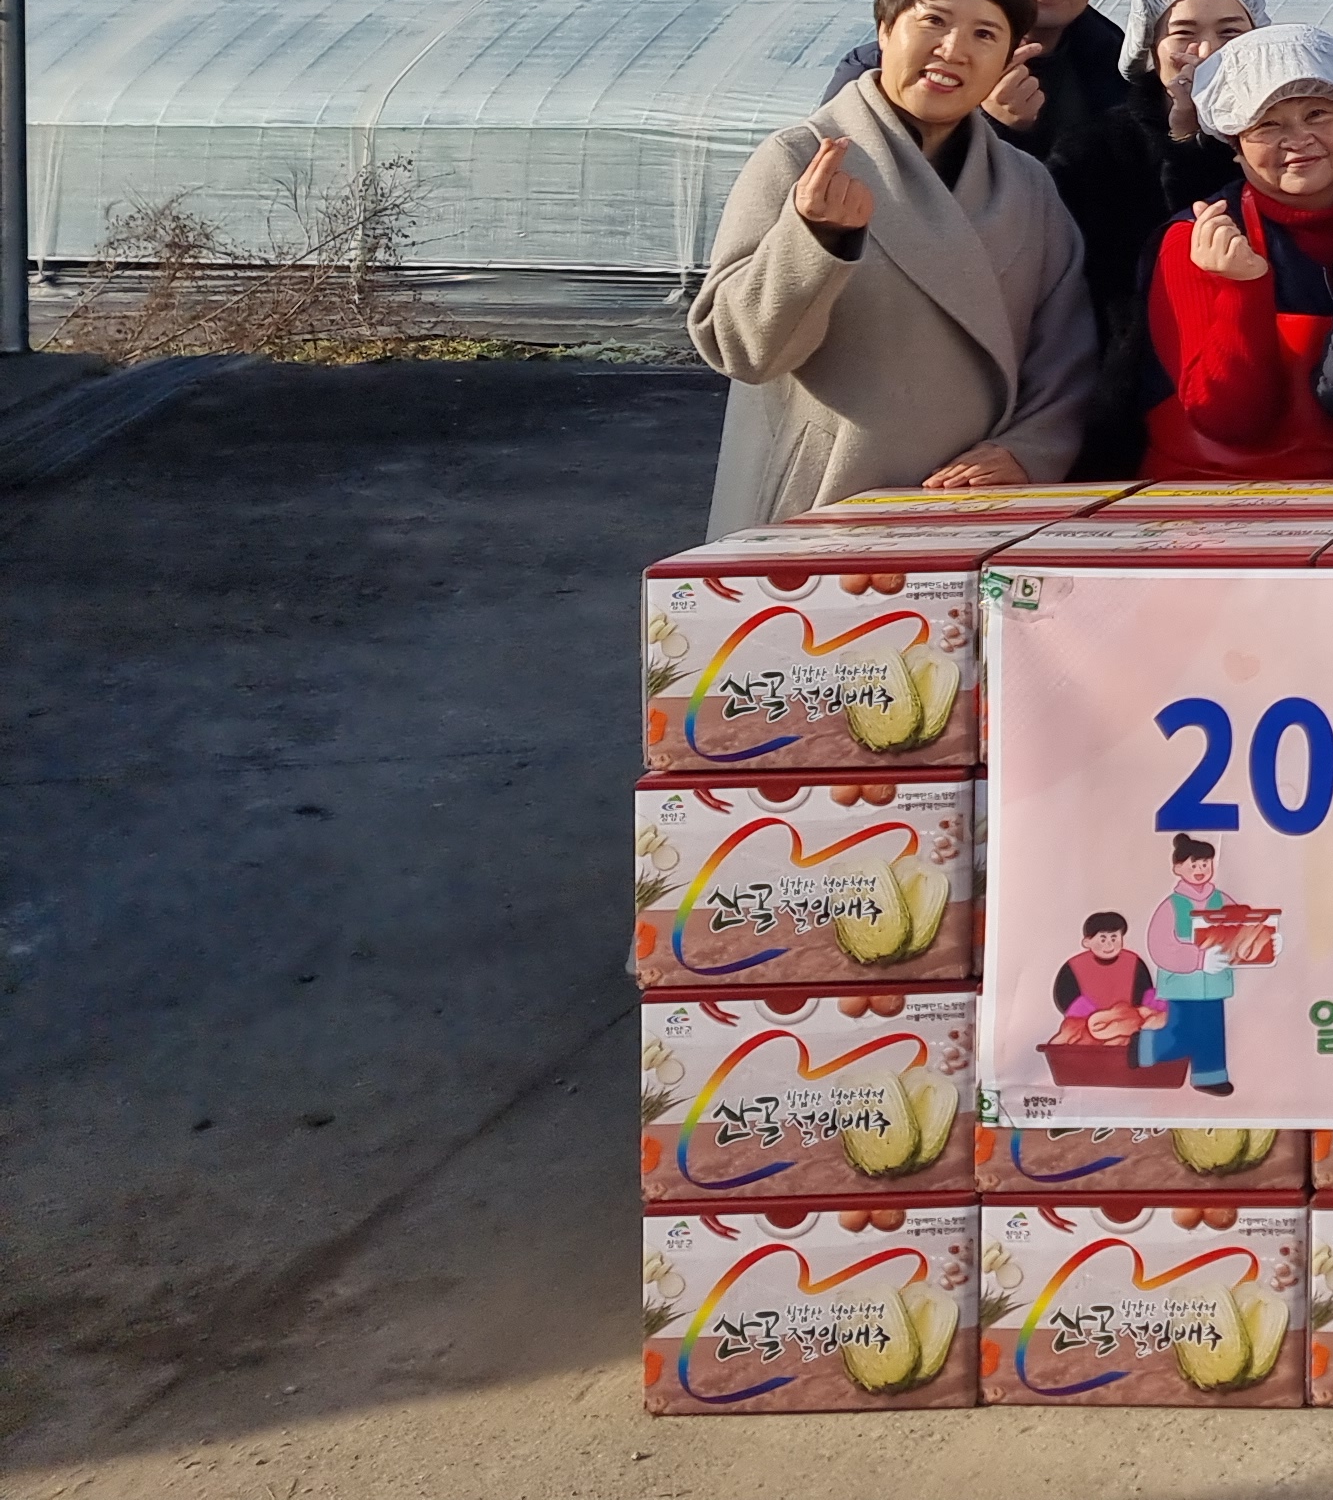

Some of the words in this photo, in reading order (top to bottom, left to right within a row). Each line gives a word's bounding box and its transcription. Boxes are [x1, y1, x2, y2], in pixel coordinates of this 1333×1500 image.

[719, 671, 788, 721] 산골
[790, 683, 895, 722] 절임배추
[707, 883, 776, 933] 산골
[778, 895, 884, 934] 절임배추
[712, 1096, 783, 1147] 산골
[784, 1107, 892, 1147] 절임배추
[713, 1311, 783, 1362] 산골
[785, 1322, 892, 1362] 절임배추
[1050, 1304, 1118, 1355] 산골
[1119, 1319, 1223, 1359] 절임배추
